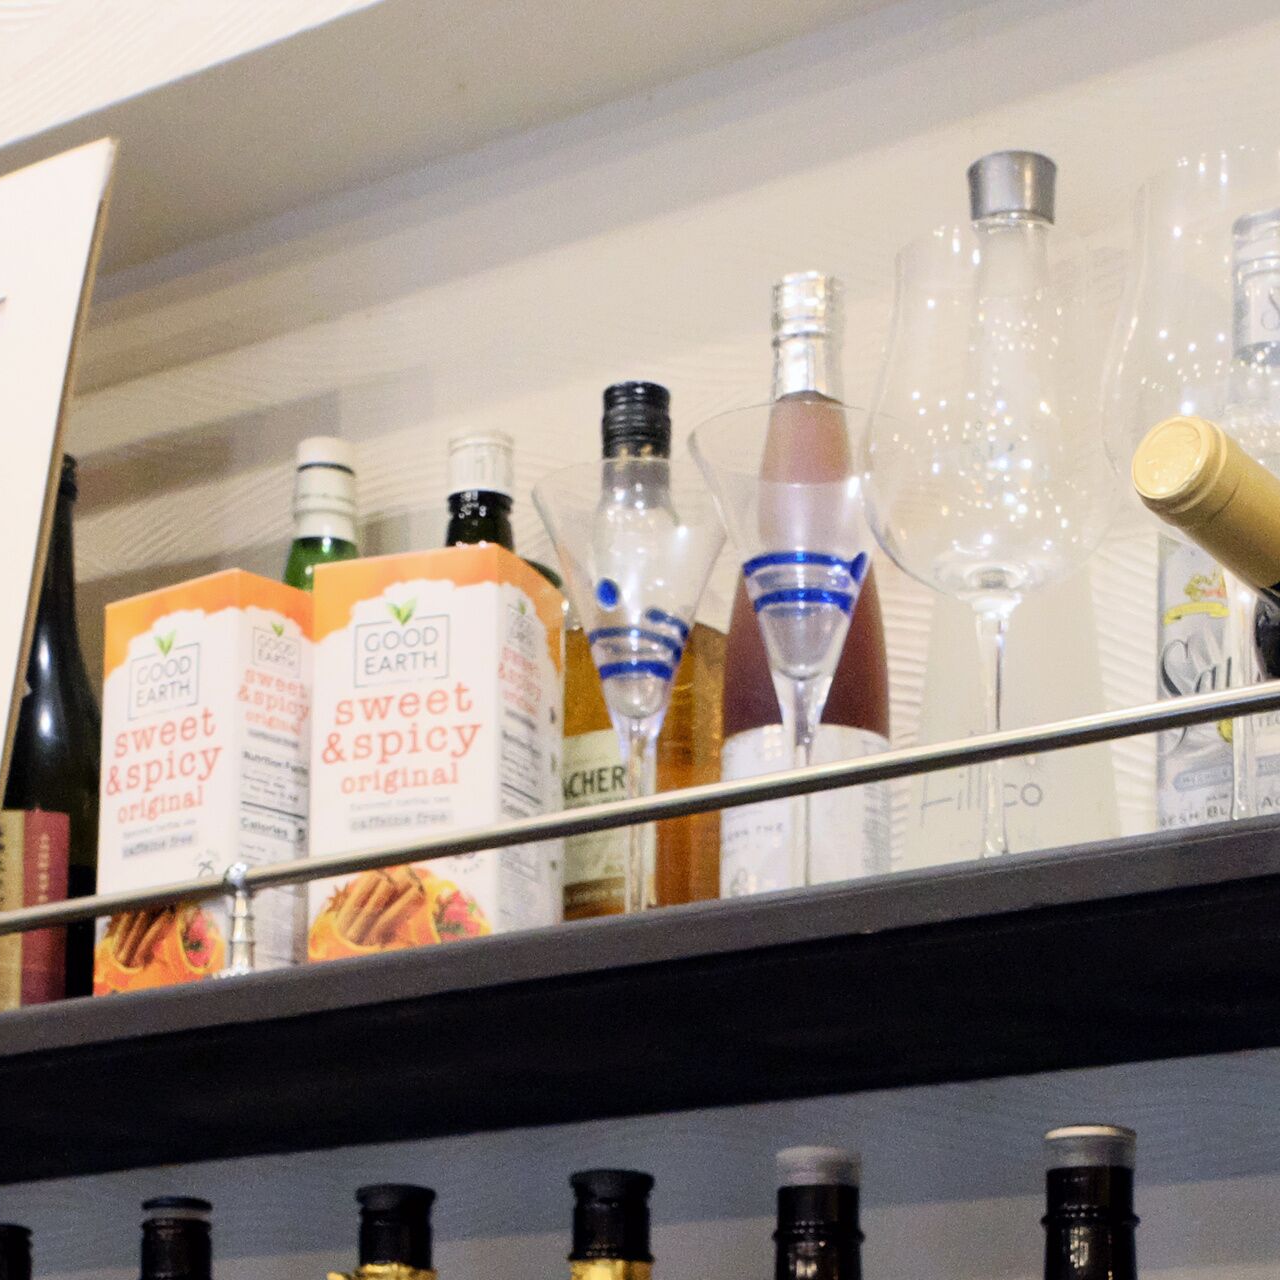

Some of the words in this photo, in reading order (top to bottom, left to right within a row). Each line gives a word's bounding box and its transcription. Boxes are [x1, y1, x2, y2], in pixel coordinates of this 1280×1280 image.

[364, 626, 439, 652] GOOD
[135, 655, 193, 686] GOOD
[364, 650, 438, 676] EARTH
[135, 680, 191, 707] EARTH
[334, 682, 473, 726] sweet
[114, 707, 217, 758] sweet
[340, 763, 460, 795] original
[116, 785, 204, 824] original
